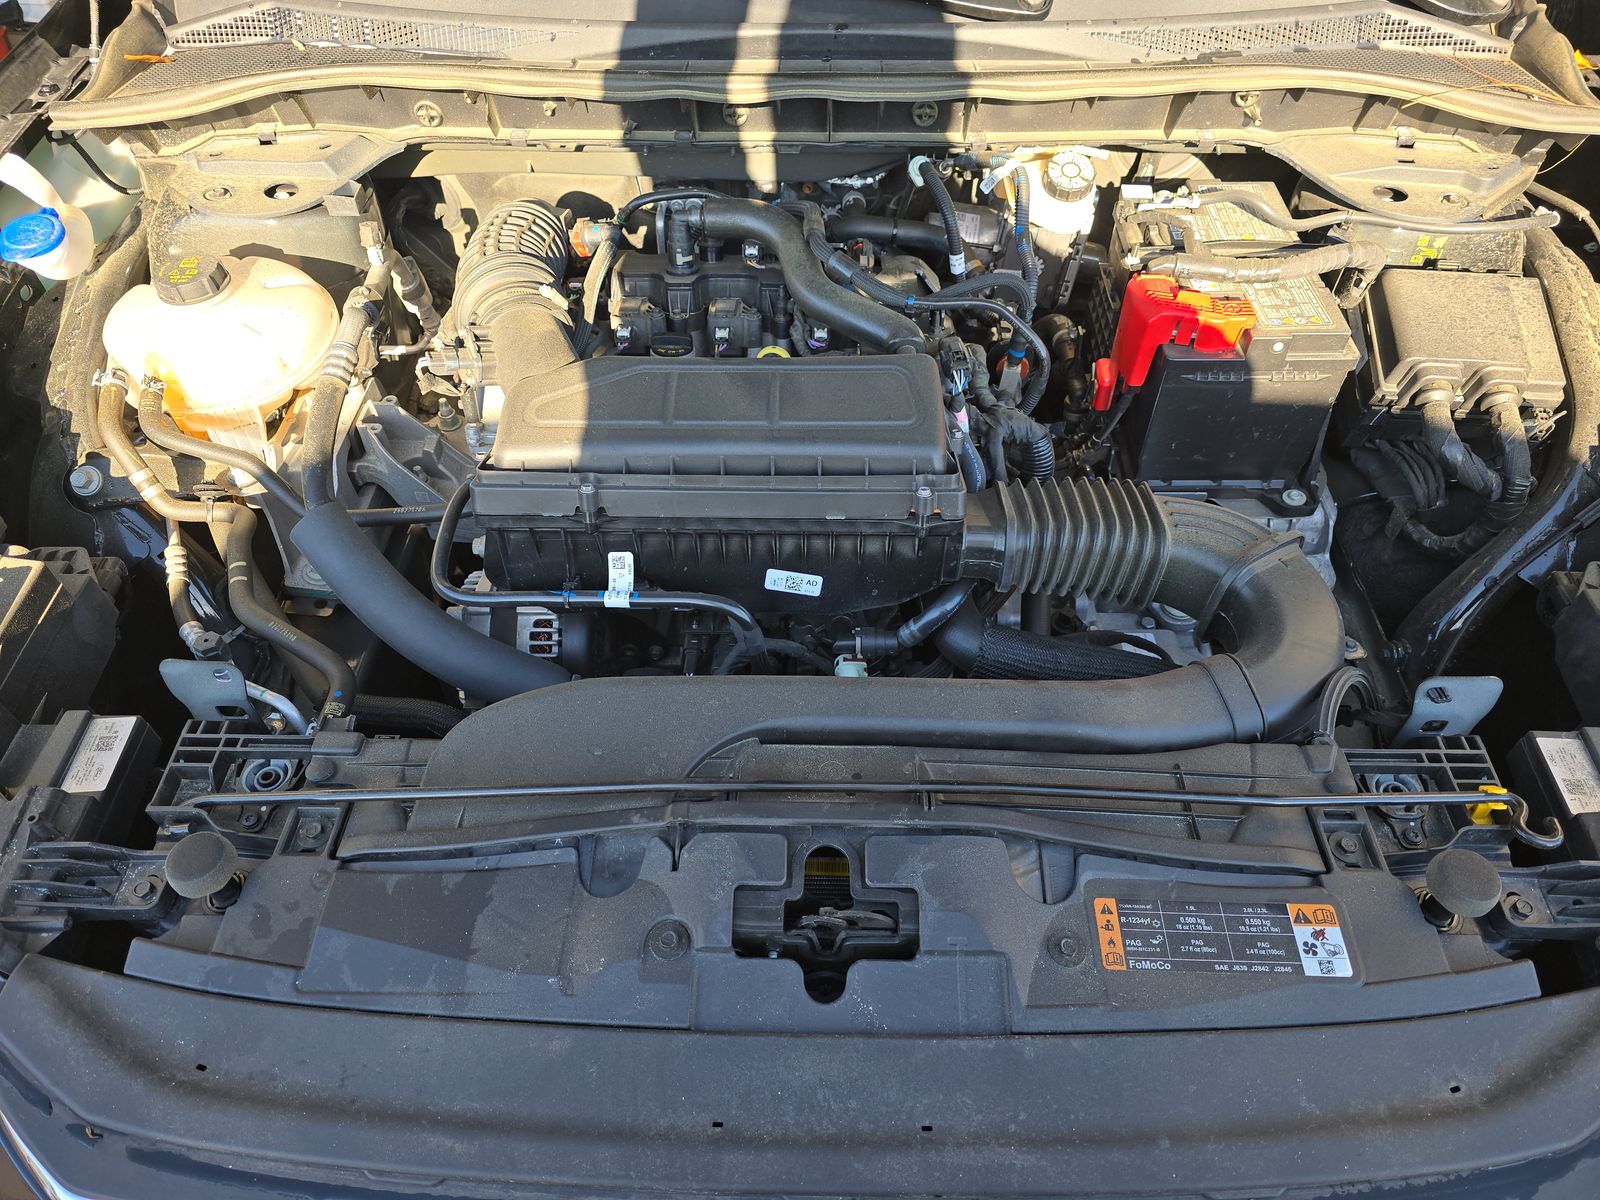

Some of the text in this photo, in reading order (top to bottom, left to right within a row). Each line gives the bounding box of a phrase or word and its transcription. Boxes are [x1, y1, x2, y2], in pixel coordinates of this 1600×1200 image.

[806, 579, 818, 587] AD
[1120, 916, 1151, 925] R-1234yf
[1197, 917, 1206, 925] kg
[1129, 960, 1171, 970] FoMoCo
